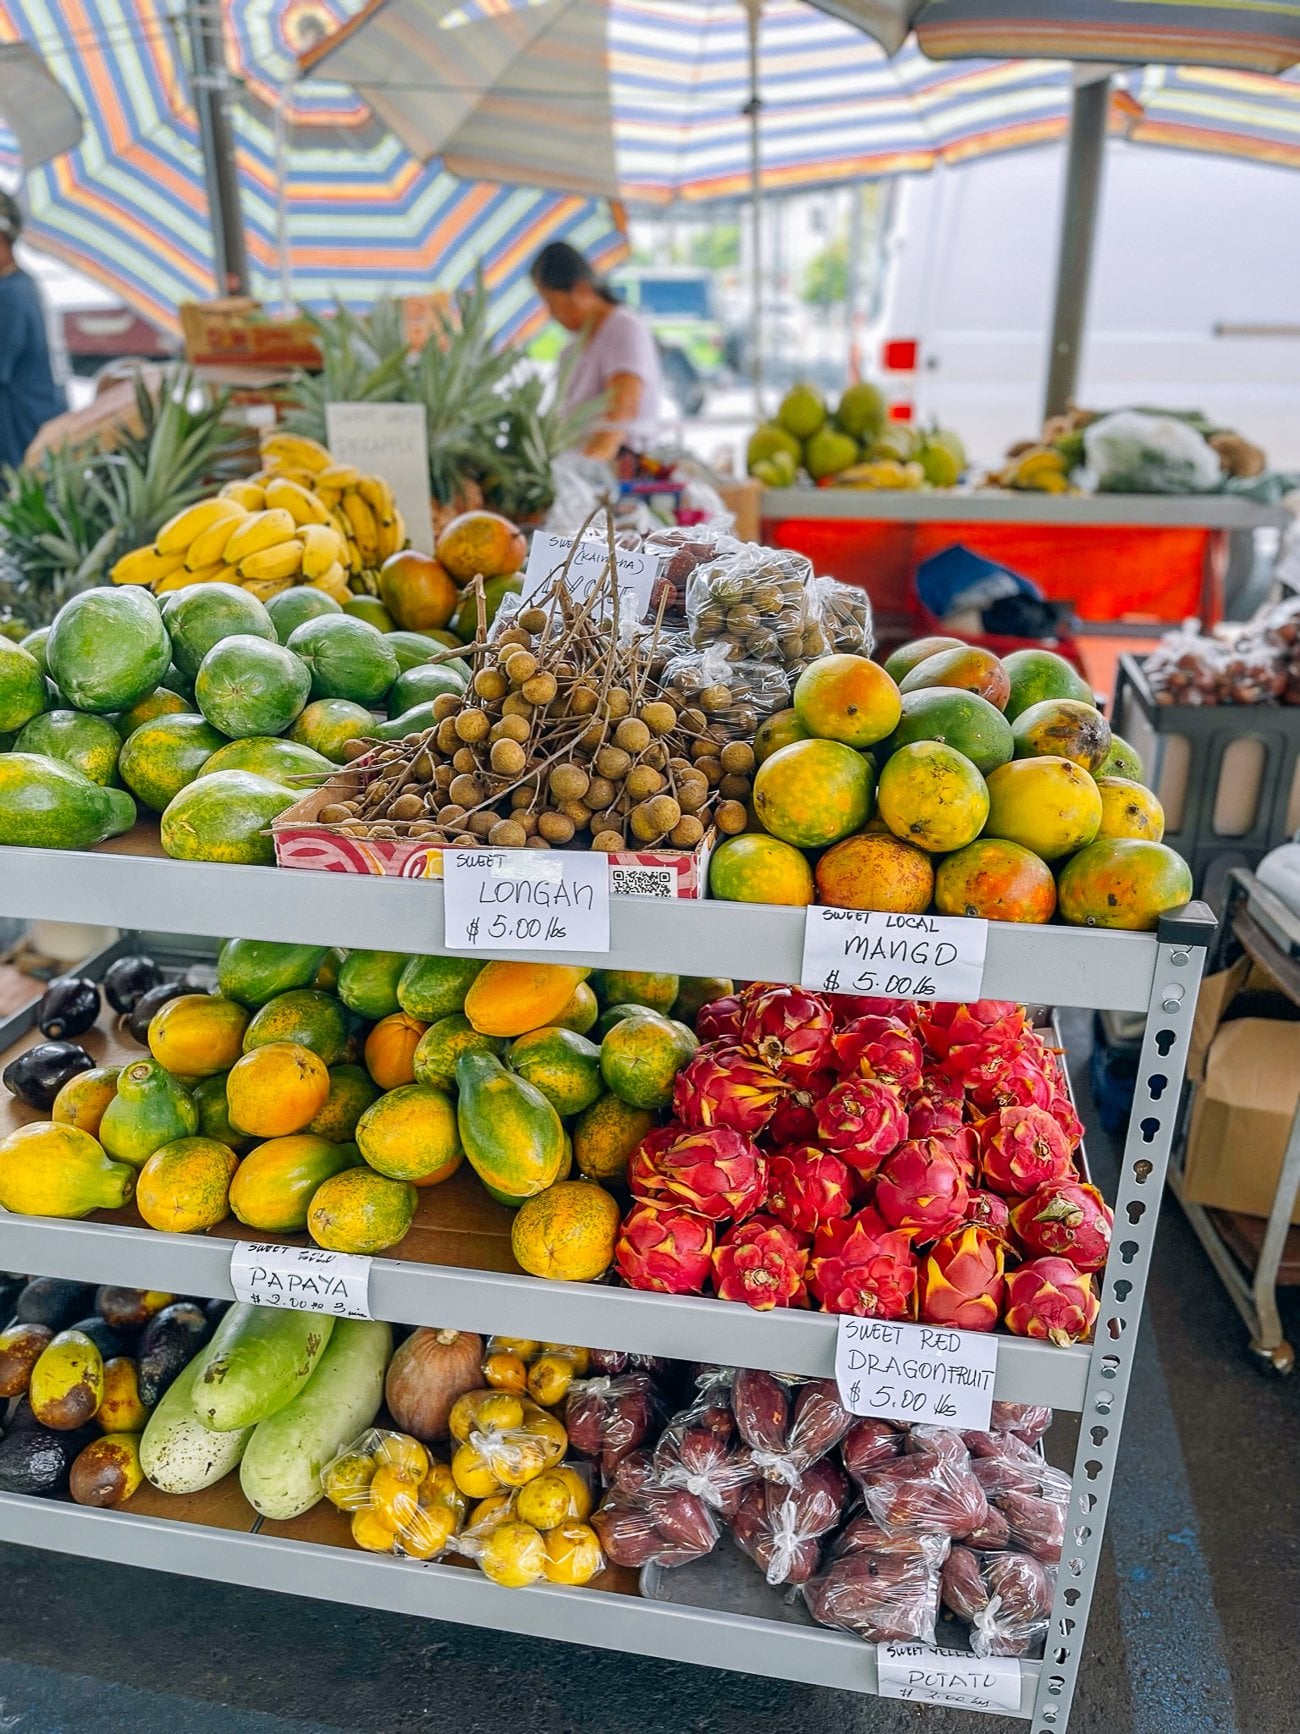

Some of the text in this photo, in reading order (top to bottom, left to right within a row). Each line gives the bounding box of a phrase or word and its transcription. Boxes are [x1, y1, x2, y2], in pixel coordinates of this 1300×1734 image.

[456, 854, 508, 868] SWEET
[479, 879, 594, 910] LONGAN
[466, 916, 480, 944] $
[822, 909, 939, 932] SWEET LOCAL
[845, 935, 957, 966] MANGO
[823, 969, 840, 991] $
[249, 1266, 348, 1298] PAPAYA
[845, 1321, 961, 1352] SWEET RED
[848, 1349, 994, 1390] DRAGONFRUIT
[848, 1380, 861, 1411] $
[870, 1386, 927, 1411] 5.00
[887, 1646, 983, 1659] SWEET YELLO
[908, 1670, 997, 1688] POTATO
